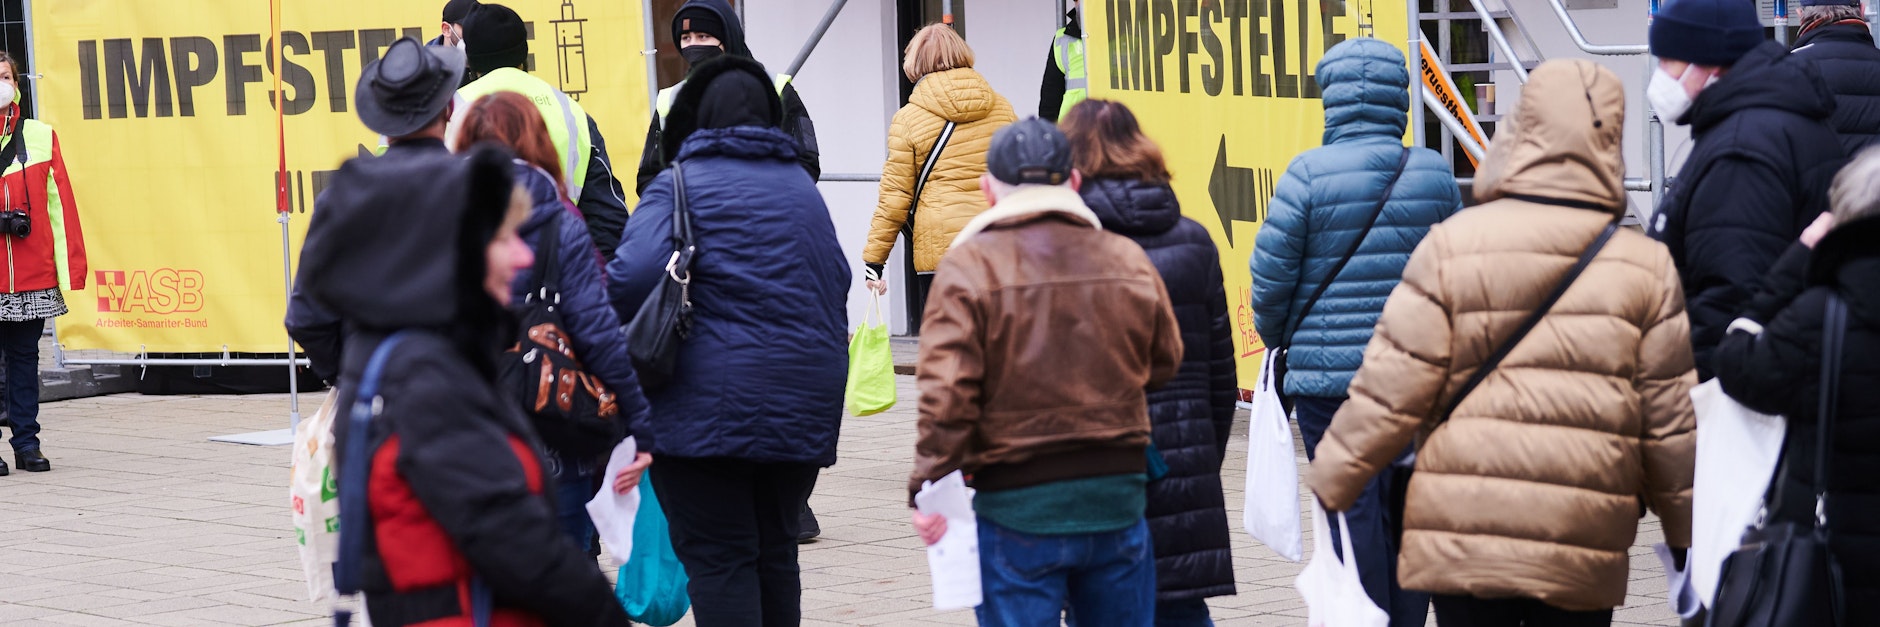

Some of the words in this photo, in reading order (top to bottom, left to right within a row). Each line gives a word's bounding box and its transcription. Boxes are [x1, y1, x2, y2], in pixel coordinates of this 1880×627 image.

[78, 21, 536, 120] IMPFST
[122, 267, 204, 314] ASB
[95, 317, 208, 328] Arbeiter-Samariter-Bund
